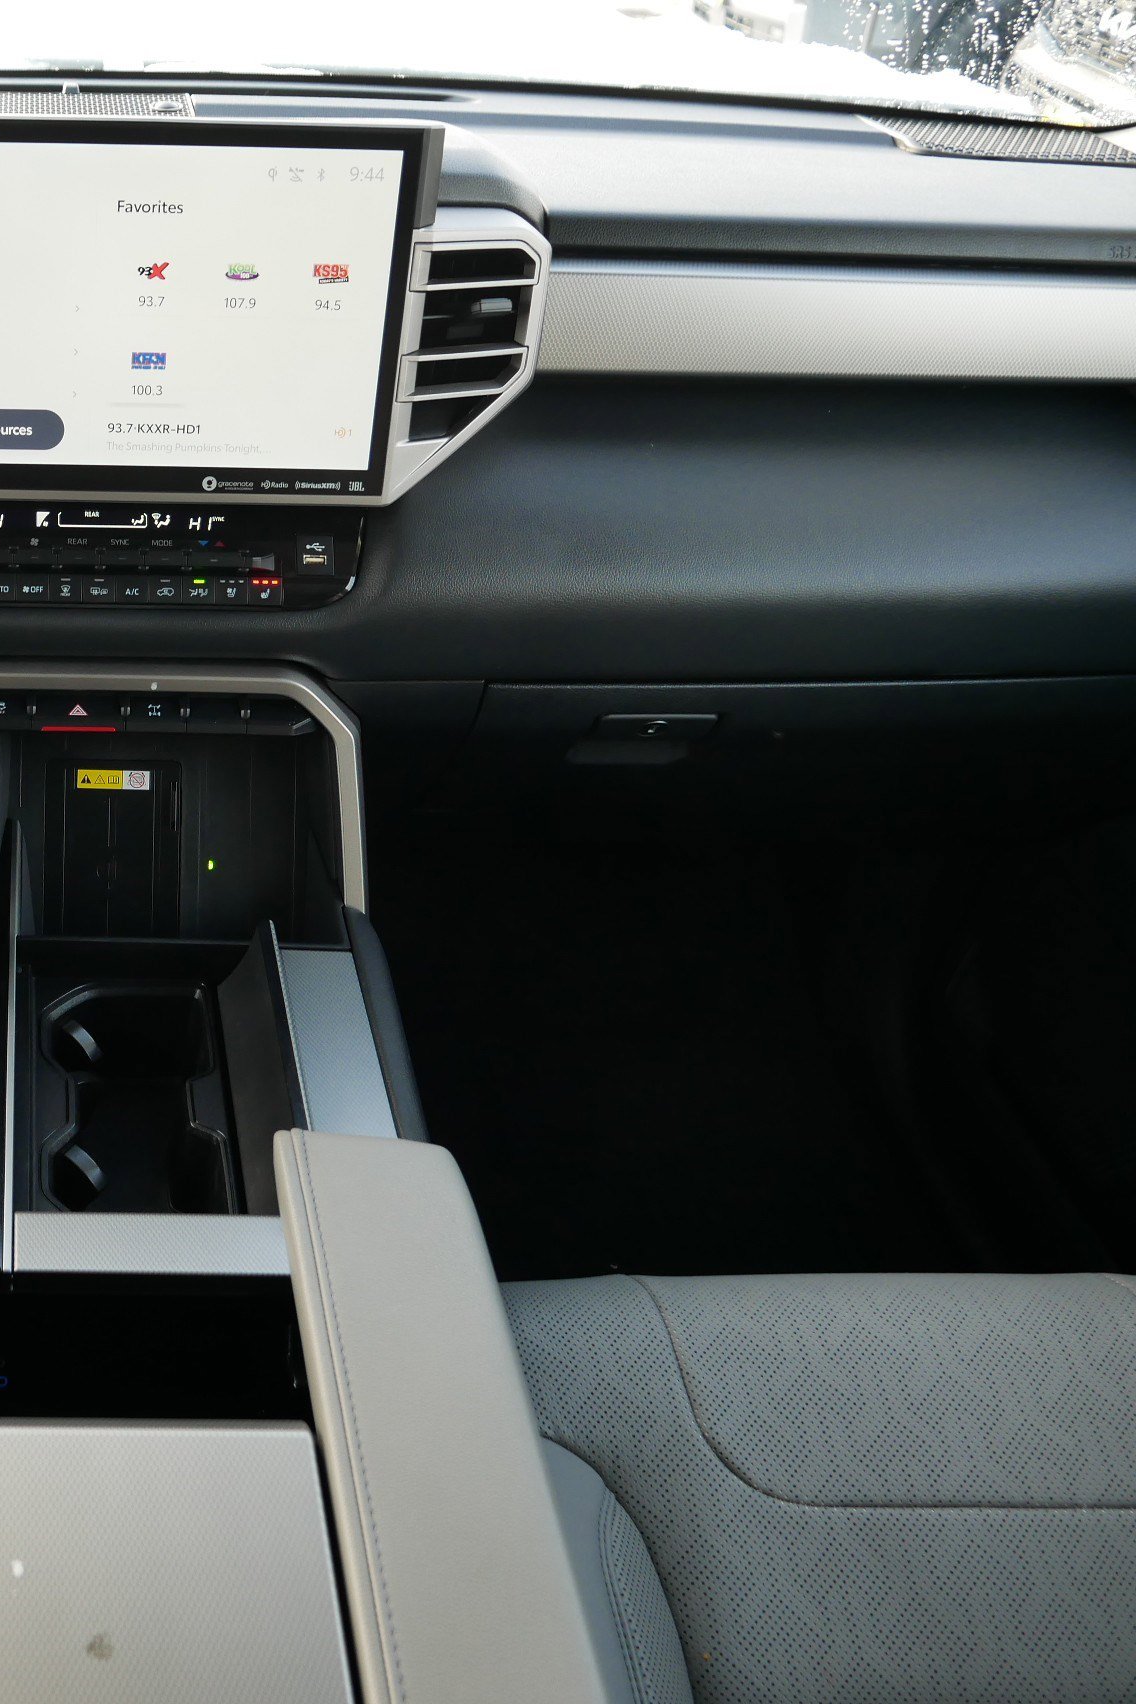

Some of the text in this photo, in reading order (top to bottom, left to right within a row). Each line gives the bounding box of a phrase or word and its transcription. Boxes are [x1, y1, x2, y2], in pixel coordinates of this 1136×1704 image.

[349, 166, 384, 181] 9:44
[117, 199, 184, 214] Favorites
[312, 263, 349, 278] KS95
[138, 295, 165, 308] 93.7
[223, 297, 257, 309] 107.9
[314, 299, 342, 311] 94.5
[131, 384, 163, 396] 100.3
[107, 440, 124, 451] The
[126, 441, 173, 454] Smashing
[175, 442, 221, 454] Pumpkins
[271, 481, 289, 489] Radio
[348, 481, 365, 492] JBL
[84, 510, 100, 518] REAR
[30, 585, 44, 593] OFF
